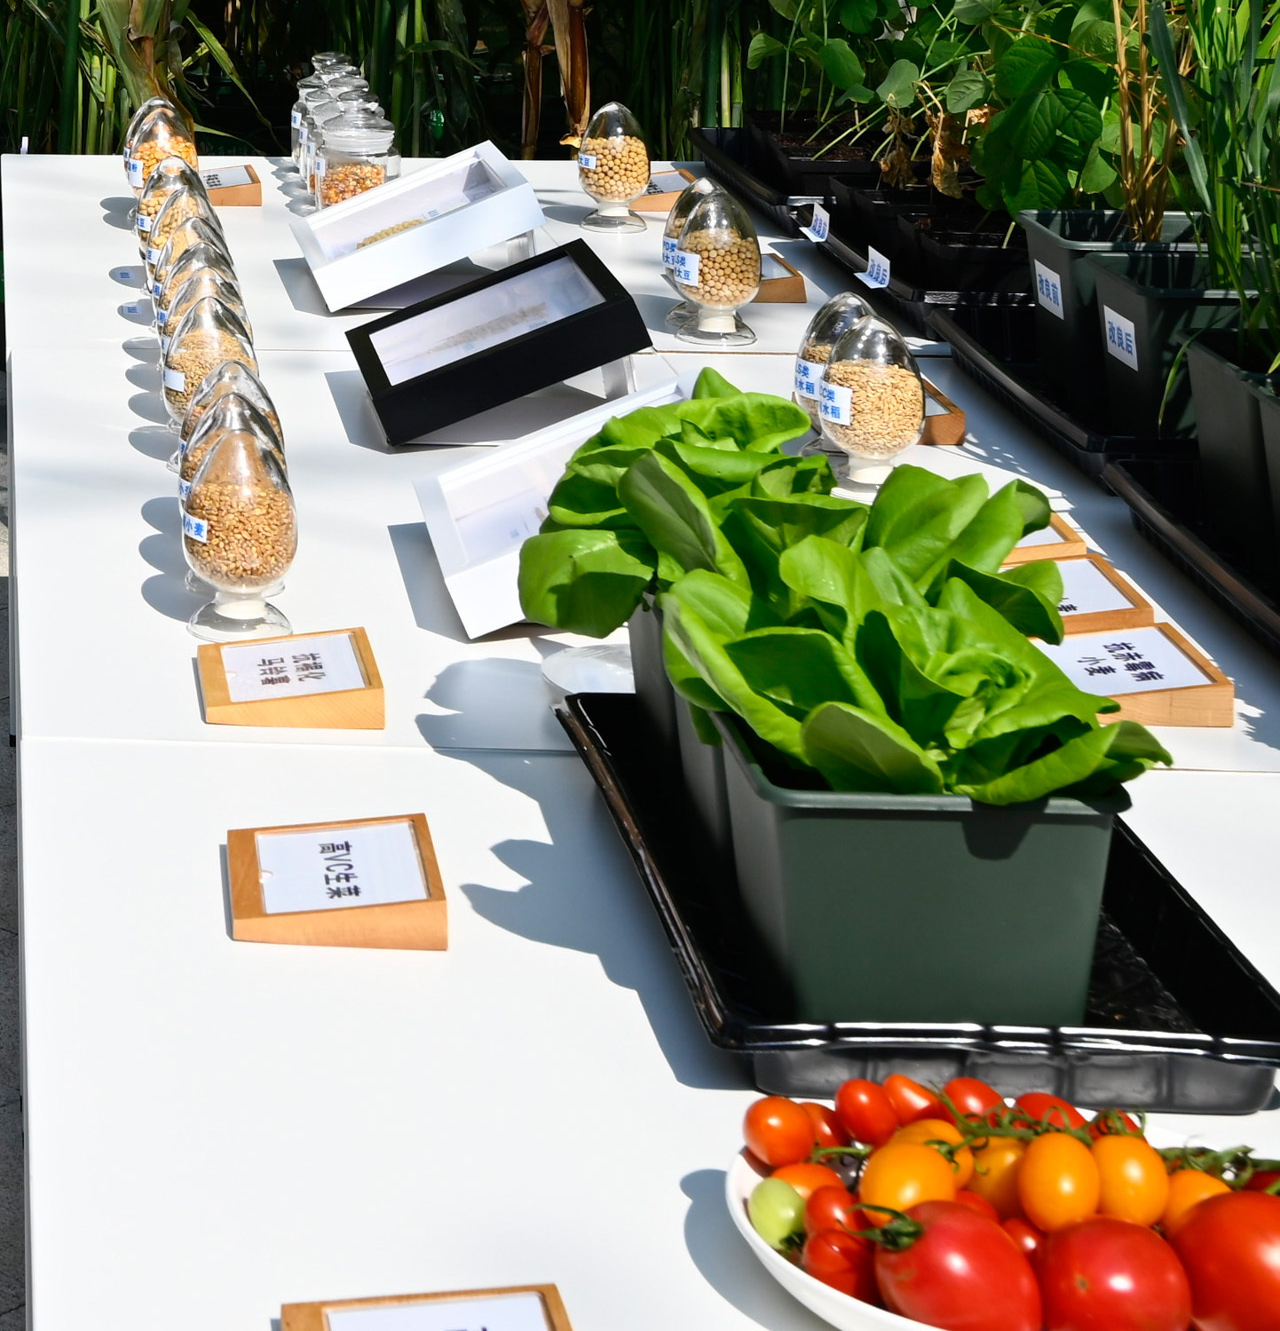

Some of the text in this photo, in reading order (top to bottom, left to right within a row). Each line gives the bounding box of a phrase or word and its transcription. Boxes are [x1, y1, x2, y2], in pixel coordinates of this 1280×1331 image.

[674, 266, 691, 281] 大豆
[868, 258, 887, 285] 改良后
[1037, 273, 1059, 306] 改良前
[1107, 320, 1134, 356] 改良后
[795, 377, 815, 395] 水稻
[820, 401, 841, 419] 水稻
[183, 513, 205, 538] 小麦
[1077, 656, 1117, 676] 小麦
[1102, 642, 1165, 682] 抗赤霉病
[318, 840, 362, 899] 高VC生菜
